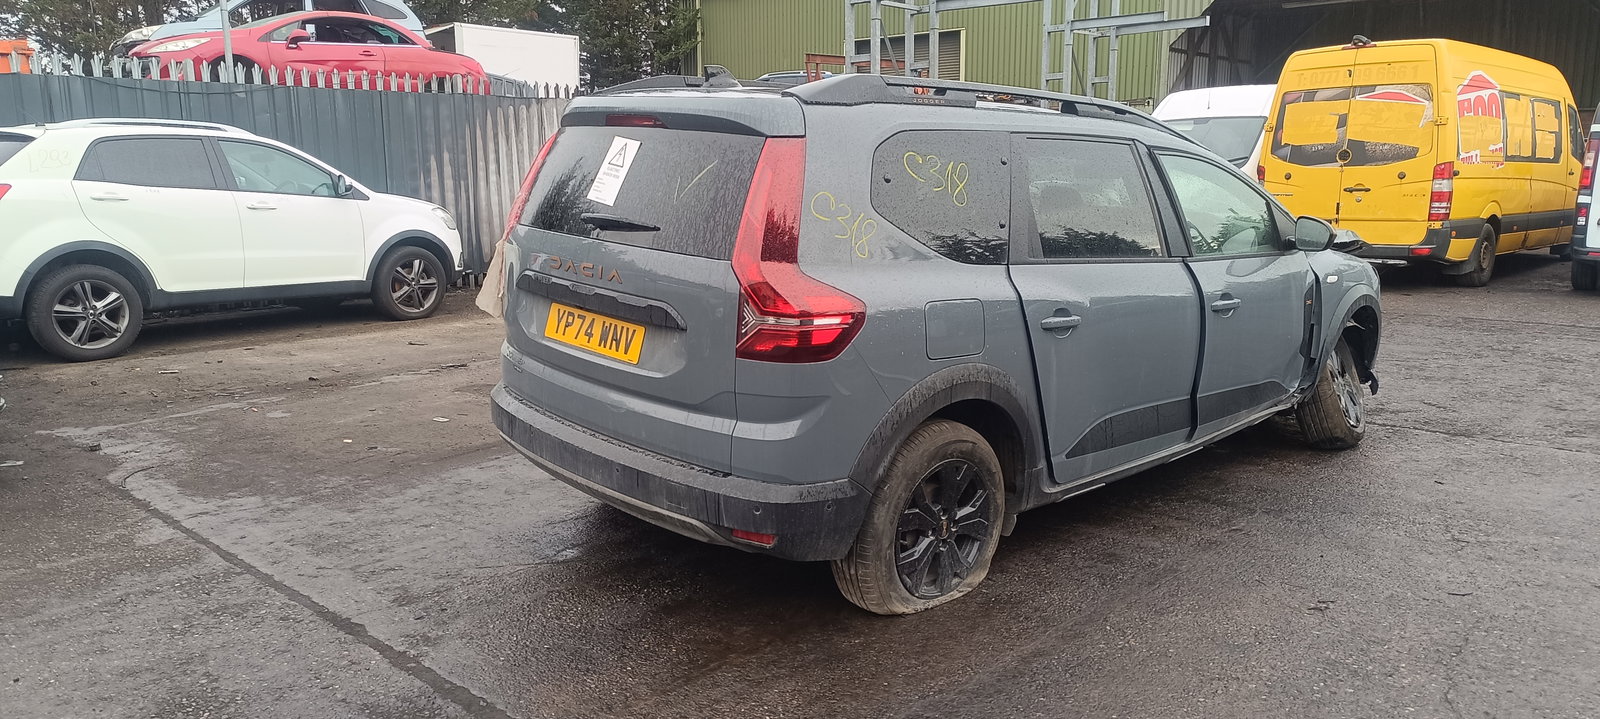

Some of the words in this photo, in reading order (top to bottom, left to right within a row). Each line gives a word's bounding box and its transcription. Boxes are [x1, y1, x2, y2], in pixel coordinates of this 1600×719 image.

[903, 151, 969, 207] C318
[810, 191, 878, 258] C318
[549, 255, 623, 284] DACIA
[555, 308, 596, 344] YP74
[597, 320, 637, 356] WNV
